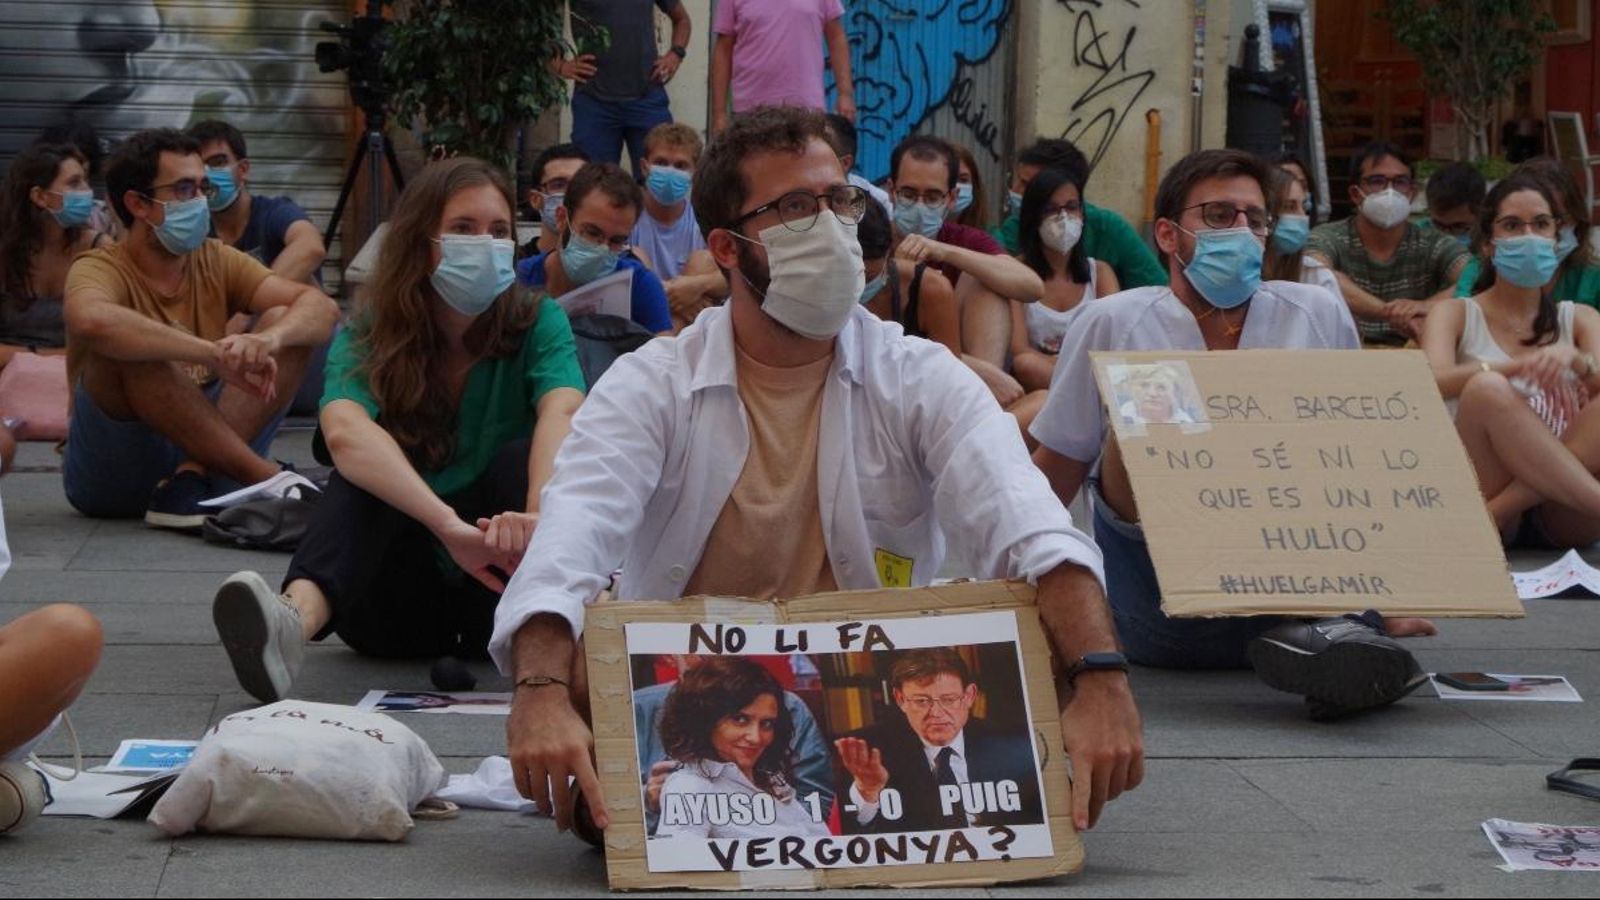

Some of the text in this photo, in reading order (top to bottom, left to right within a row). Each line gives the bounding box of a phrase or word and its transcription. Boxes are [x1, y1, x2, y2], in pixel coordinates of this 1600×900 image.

[1206, 391, 1420, 421] SRA. BARCELÓ:
[1252, 441, 1292, 470] SÉ
[1319, 444, 1354, 470] NI
[1381, 448, 1419, 470] LO
[1199, 487, 1253, 510] QUE
[1268, 486, 1301, 509] ES
[1324, 486, 1372, 509] UN
[688, 621, 896, 655] NO LI FA
[664, 791, 777, 827] AYUSO
[803, 790, 824, 825] 1
[938, 779, 1022, 818] PUIG
